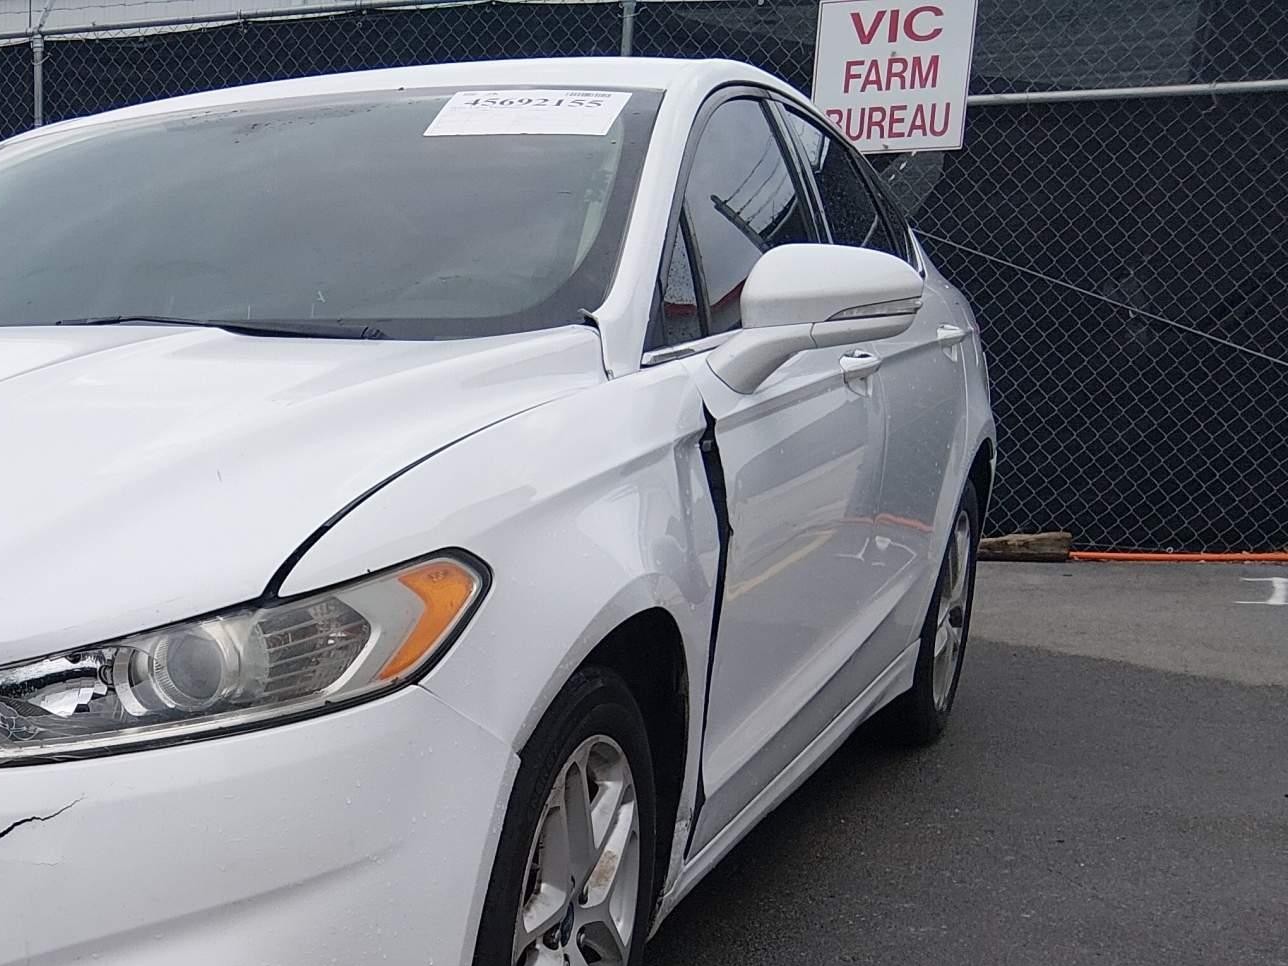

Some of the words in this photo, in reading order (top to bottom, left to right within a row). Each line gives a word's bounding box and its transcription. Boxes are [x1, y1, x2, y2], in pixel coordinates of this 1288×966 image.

[850, 5, 944, 45] VIC
[843, 54, 940, 94] FARM
[464, 98, 604, 108] 45692155
